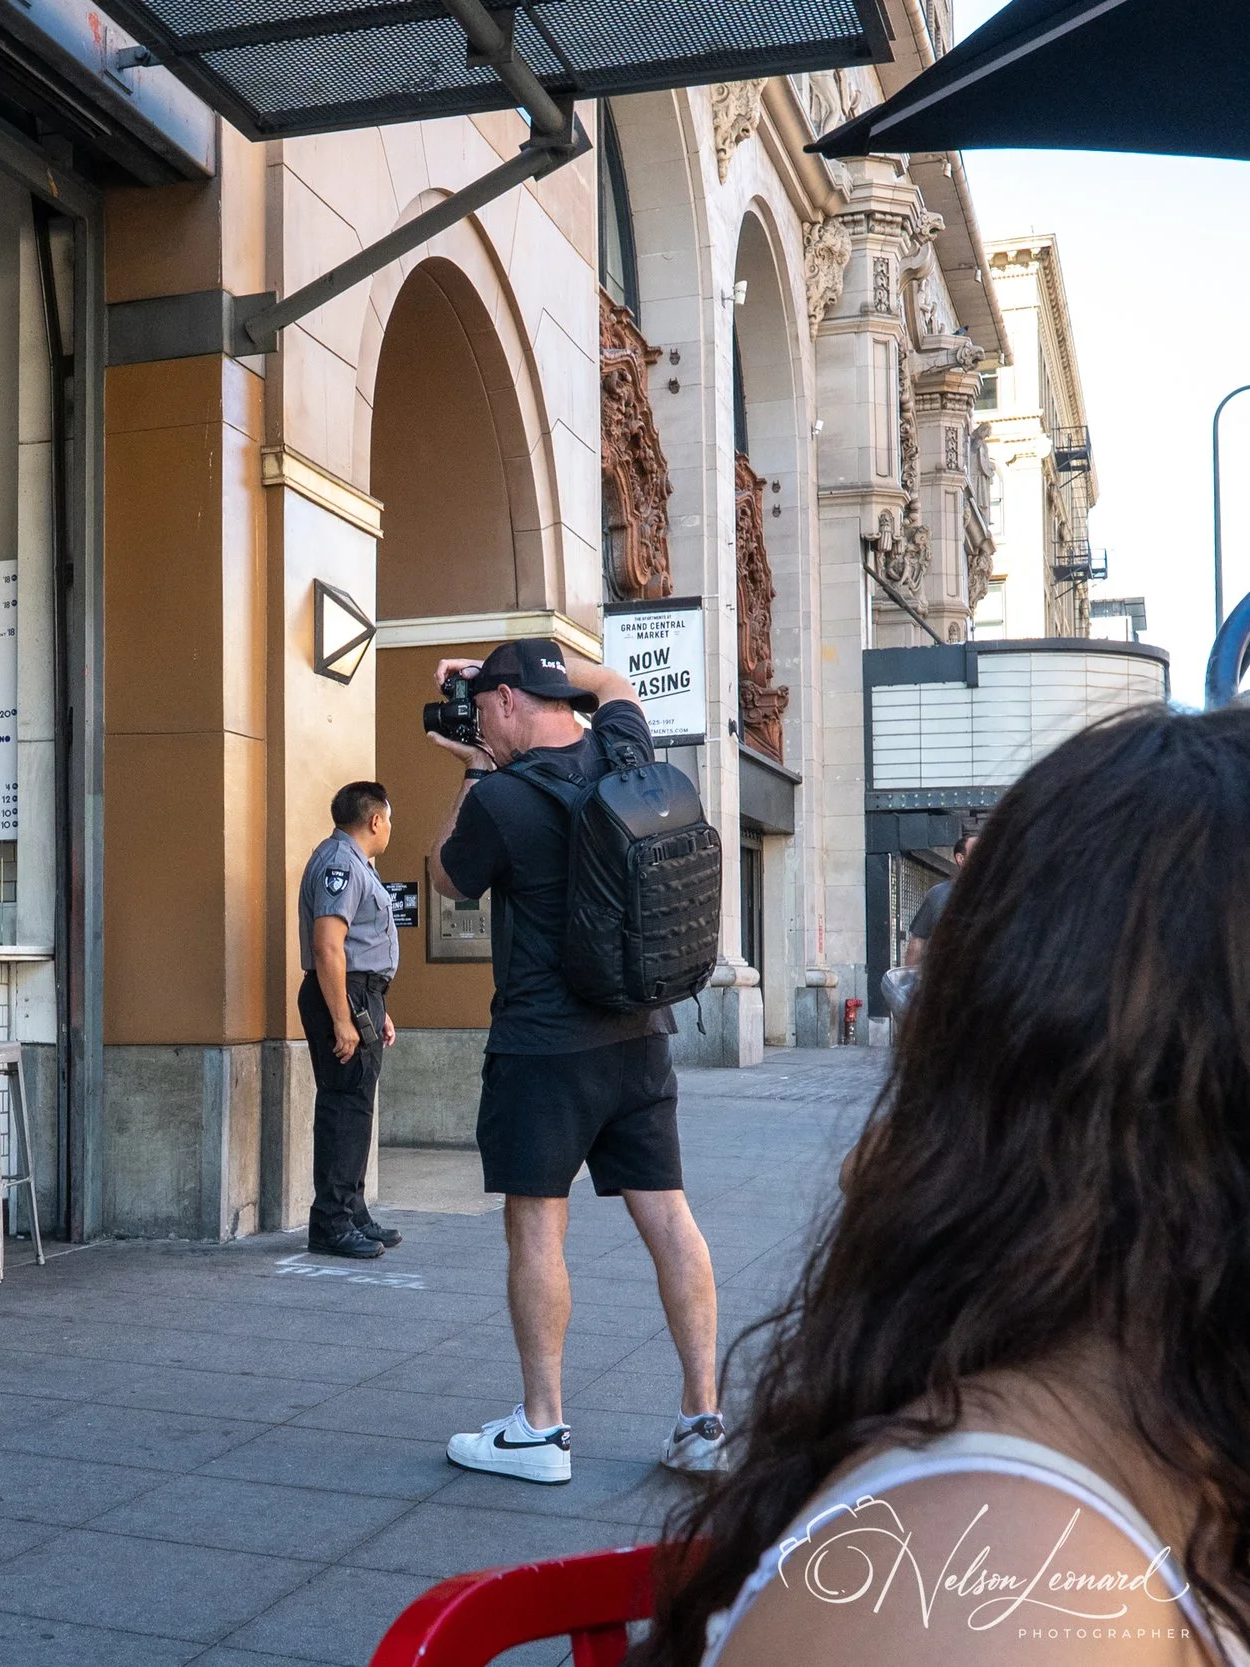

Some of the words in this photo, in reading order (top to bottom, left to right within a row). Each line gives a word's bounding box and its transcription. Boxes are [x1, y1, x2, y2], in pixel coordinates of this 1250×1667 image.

[620, 622, 648, 632] GRAND
[650, 619, 686, 630] CENTRAL
[636, 630, 670, 640] MARKET
[629, 646, 670, 673] NOW
[631, 670, 691, 698] ASING
